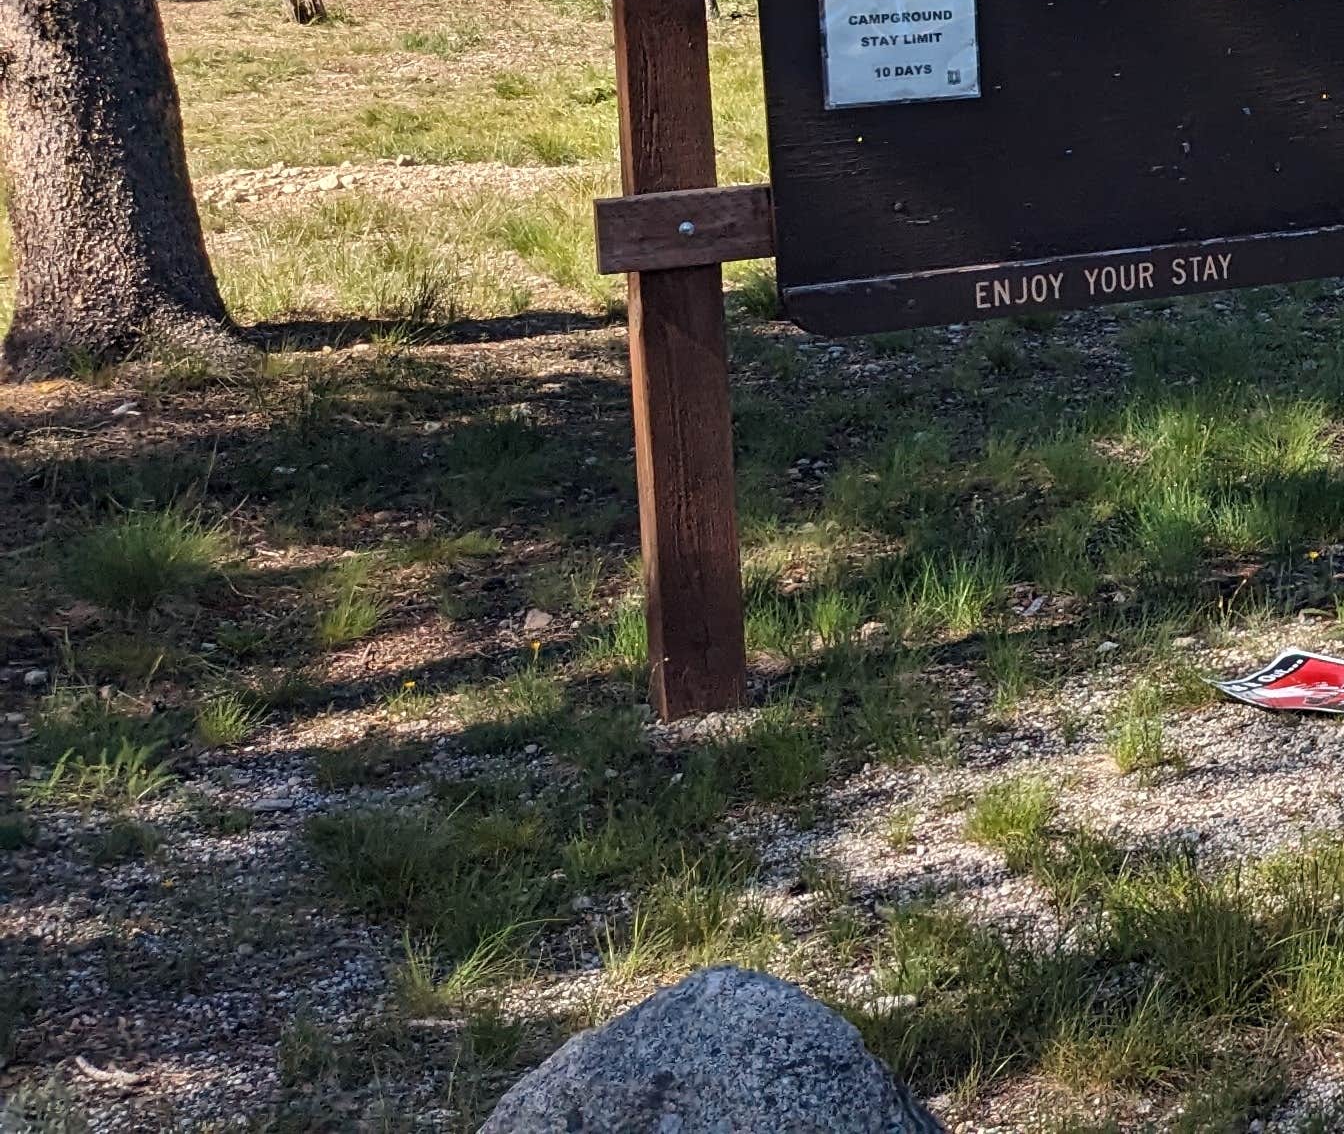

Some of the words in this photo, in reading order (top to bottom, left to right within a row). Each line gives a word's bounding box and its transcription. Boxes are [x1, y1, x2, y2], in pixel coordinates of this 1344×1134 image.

[848, 10, 953, 26] CAMPGROUND
[861, 35, 899, 47] STAY
[903, 32, 943, 45] LIMIT
[875, 67, 891, 78] 10
[895, 64, 933, 77] DAYS
[975, 272, 1064, 309] ENJOY
[1084, 262, 1155, 295] YOUR
[1171, 253, 1232, 286] STAY
